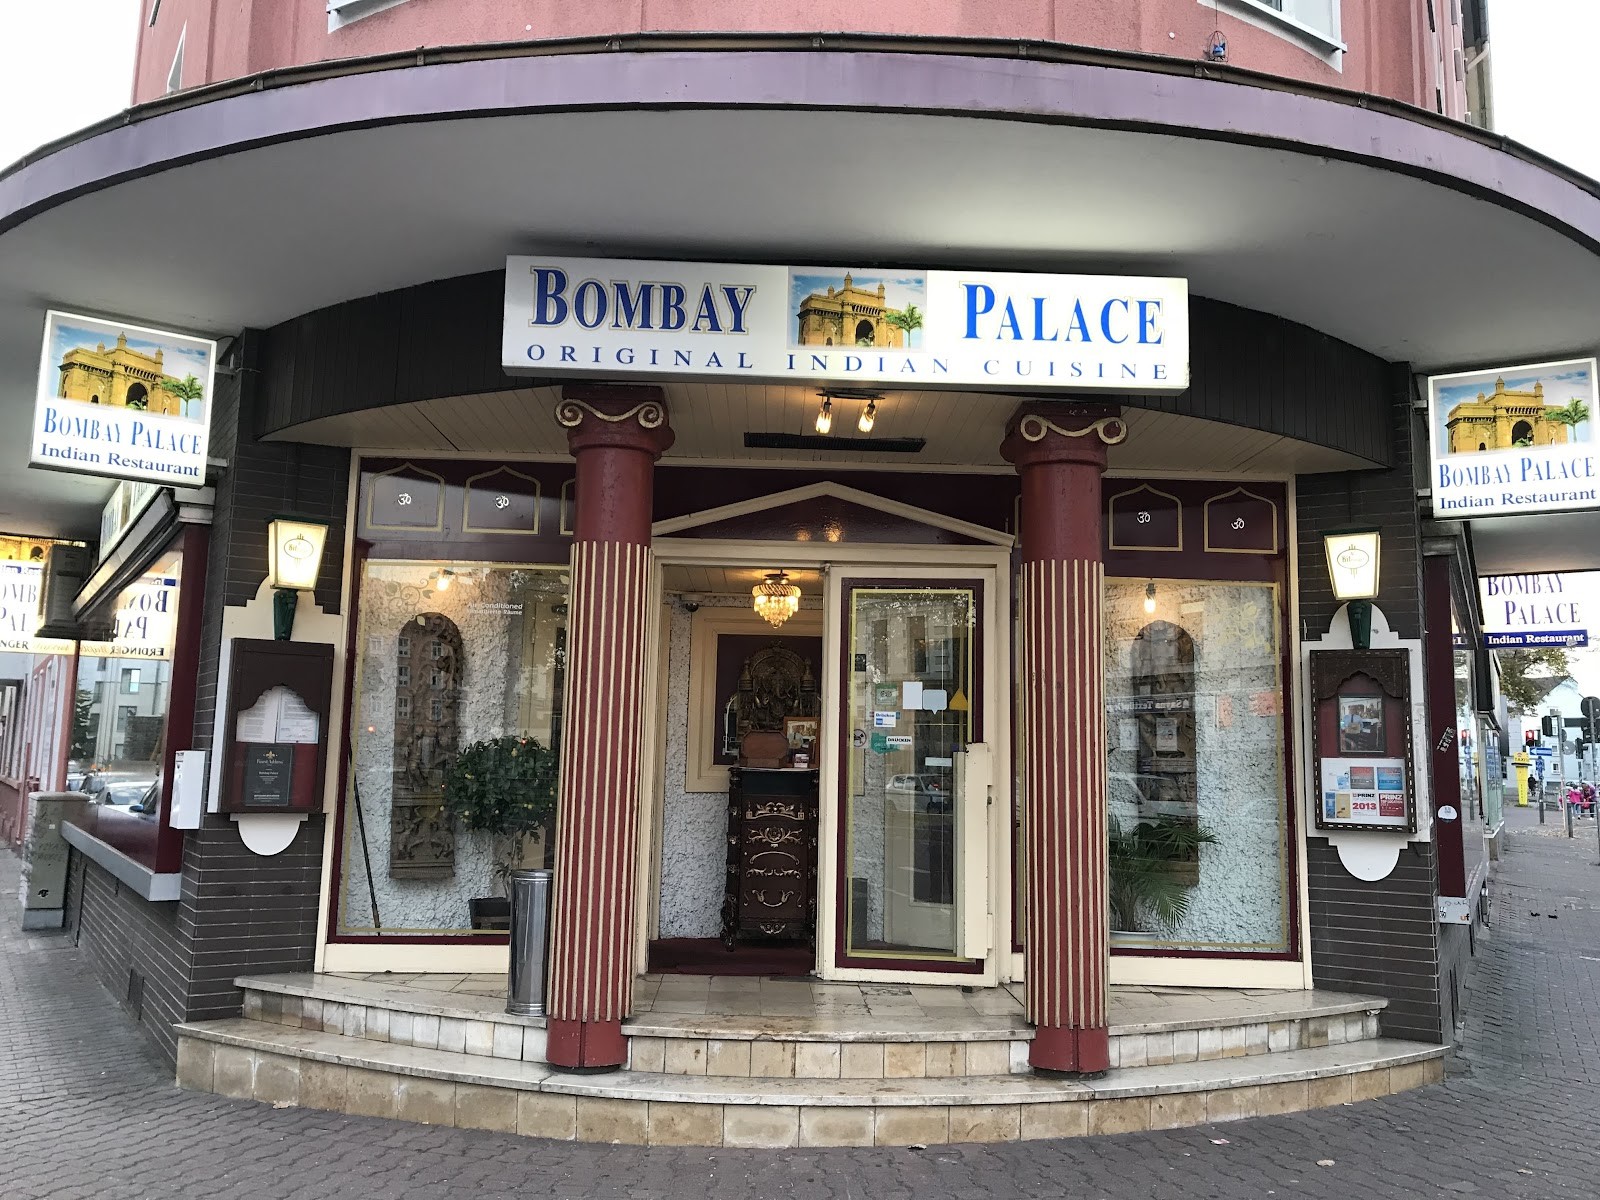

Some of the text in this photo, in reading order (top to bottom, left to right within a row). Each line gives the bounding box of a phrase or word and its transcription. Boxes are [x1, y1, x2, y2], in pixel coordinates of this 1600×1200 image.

[529, 265, 1166, 346] BOMBAY PALACE
[527, 344, 1168, 380] ORIGINAL INDIAN CUISINE
[43, 407, 202, 455] BOMBAY PALACE
[40, 442, 200, 477] Indian Restaurant
[1439, 457, 1595, 488] BOMBAY PALACE
[1440, 488, 1597, 509] Indian Restaurant
[1487, 573, 1565, 596] BOMBAY
[1504, 600, 1581, 625] PALACE
[1488, 633, 1585, 645] Indian Restaurant
[1352, 802, 1377, 810] 2013
